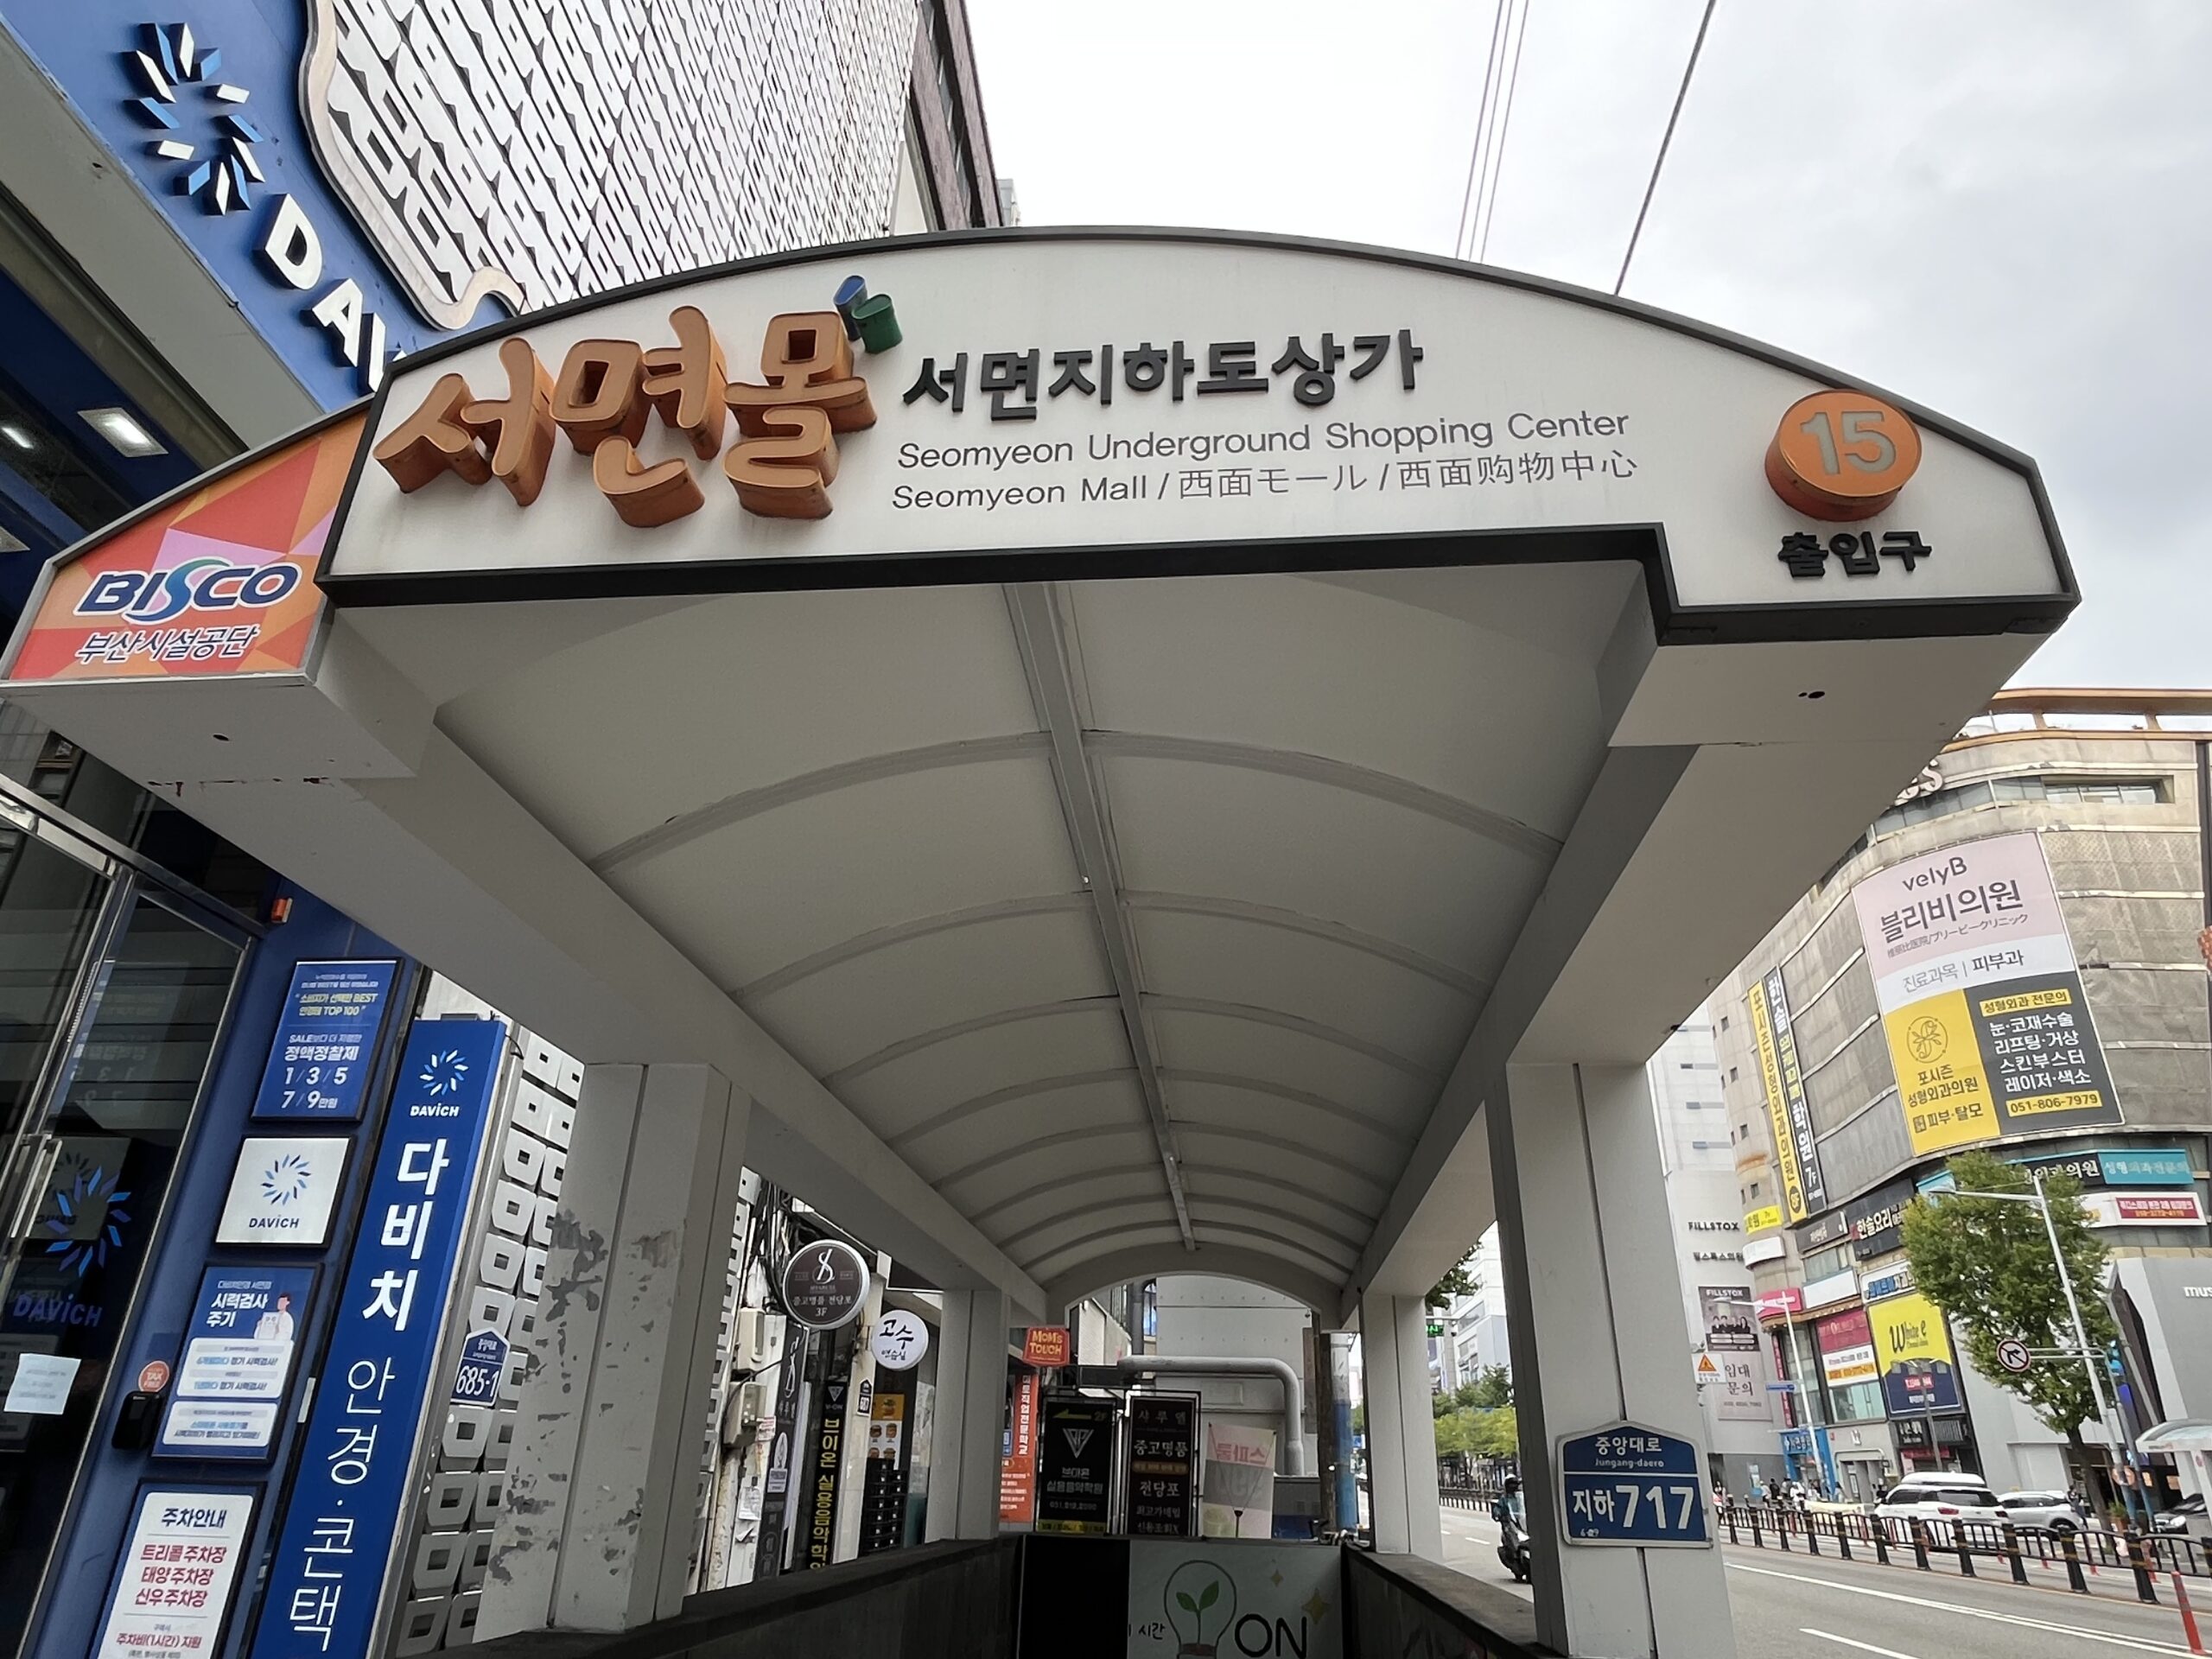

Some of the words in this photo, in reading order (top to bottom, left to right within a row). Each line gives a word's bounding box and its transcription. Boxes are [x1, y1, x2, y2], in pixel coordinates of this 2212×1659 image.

[903, 328, 1423, 422] 서면지하도상가
[372, 305, 877, 527] 서면몰
[898, 441, 1073, 471] Seomyeon
[1089, 425, 1309, 461] Underground
[1326, 417, 1493, 454] Shopping
[1508, 410, 1630, 440] Center
[1800, 410, 1897, 475] 15
[893, 484, 1065, 512] Seomyeon
[1082, 475, 1147, 503] Mall
[1778, 530, 1932, 577] 출입구
[75, 558, 300, 622] BISCO
[76, 626, 260, 664] 부산시설공단
[1902, 856, 1967, 891] velyB
[1881, 879, 2024, 944] 블리비의원
[1904, 963, 1958, 994] 진료과목
[1972, 949, 2024, 972] 피부과
[323, 1007, 343, 1016] TOP
[1984, 995, 2031, 1014] 성형외과
[2031, 991, 2068, 1005] 전문의
[284, 1046, 359, 1062] 정액정찰제
[1999, 1049, 2087, 1074] 스킨부스터
[1917, 1064, 1954, 1086] 포시즌
[1908, 1077, 1980, 1109] 성형외과의원
[2011, 1093, 2098, 1114] 051-806-7979
[363, 1137, 450, 1332] 다비치
[1688, 1222, 1739, 1231] FILLSTOX
[211, 1293, 269, 1310] 시력검사
[815, 1306, 828, 1318] 3F
[207, 1312, 237, 1328] 주기
[879, 1319, 914, 1350] 고수
[1029, 1342, 1063, 1356] TOUCH
[1725, 1363, 1751, 1378] 임대
[1727, 1382, 1754, 1396] 문의
[1134, 1439, 1189, 1458] 중고명품
[1595, 1436, 1662, 1456] 중앙대로
[1595, 1458, 1665, 1469] Jungang-daero
[1140, 1479, 1181, 1498] 전당포
[162, 1508, 227, 1529] 주차안내
[140, 1544, 184, 1561] 트리콜
[183, 1546, 227, 1564] 주차장
[141, 1566, 169, 1585] 태양
[170, 1567, 214, 1586] 주차장
[135, 1588, 164, 1605] 신우
[164, 1589, 207, 1608] 주차장
[1138, 1622, 1166, 1640] 시간
[1234, 1613, 1307, 1659] ON
[181, 1636, 202, 1649] 지원
